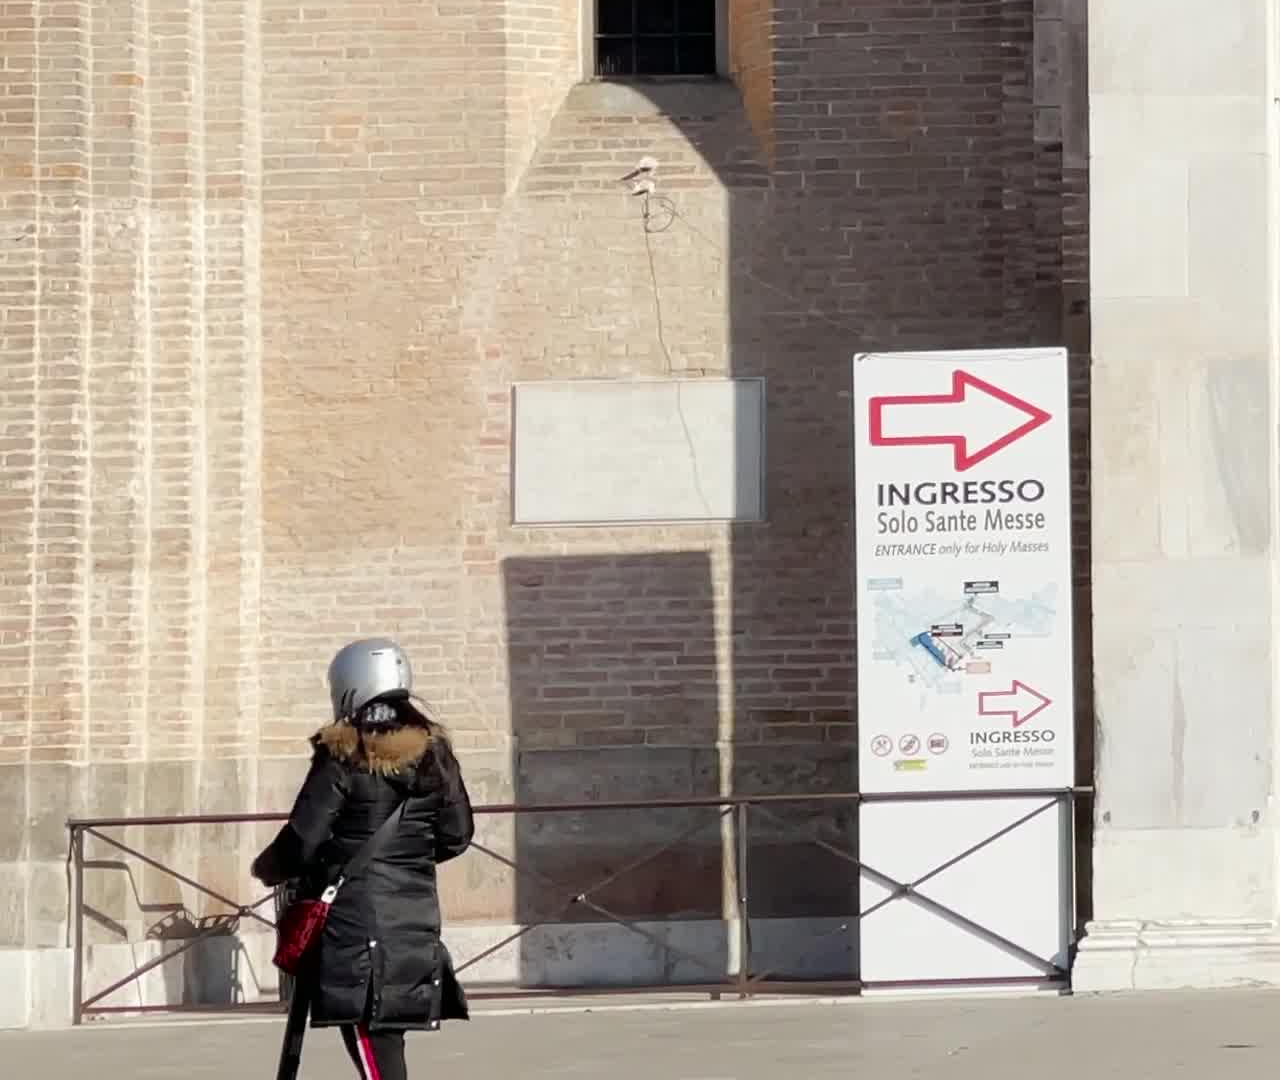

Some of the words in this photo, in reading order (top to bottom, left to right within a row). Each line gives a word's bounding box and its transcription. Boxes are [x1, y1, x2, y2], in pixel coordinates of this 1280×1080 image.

[878, 480, 1045, 506] INGRESSO
[878, 511, 918, 533] Solo
[925, 510, 977, 532] Sante
[984, 509, 1045, 530] Messe
[875, 543, 937, 558] ENTRANCE
[938, 543, 963, 557] only
[964, 541, 980, 554] for
[982, 541, 1008, 557] Holy
[1009, 540, 1049, 553] Masses
[970, 730, 1056, 745] INGRESSO
